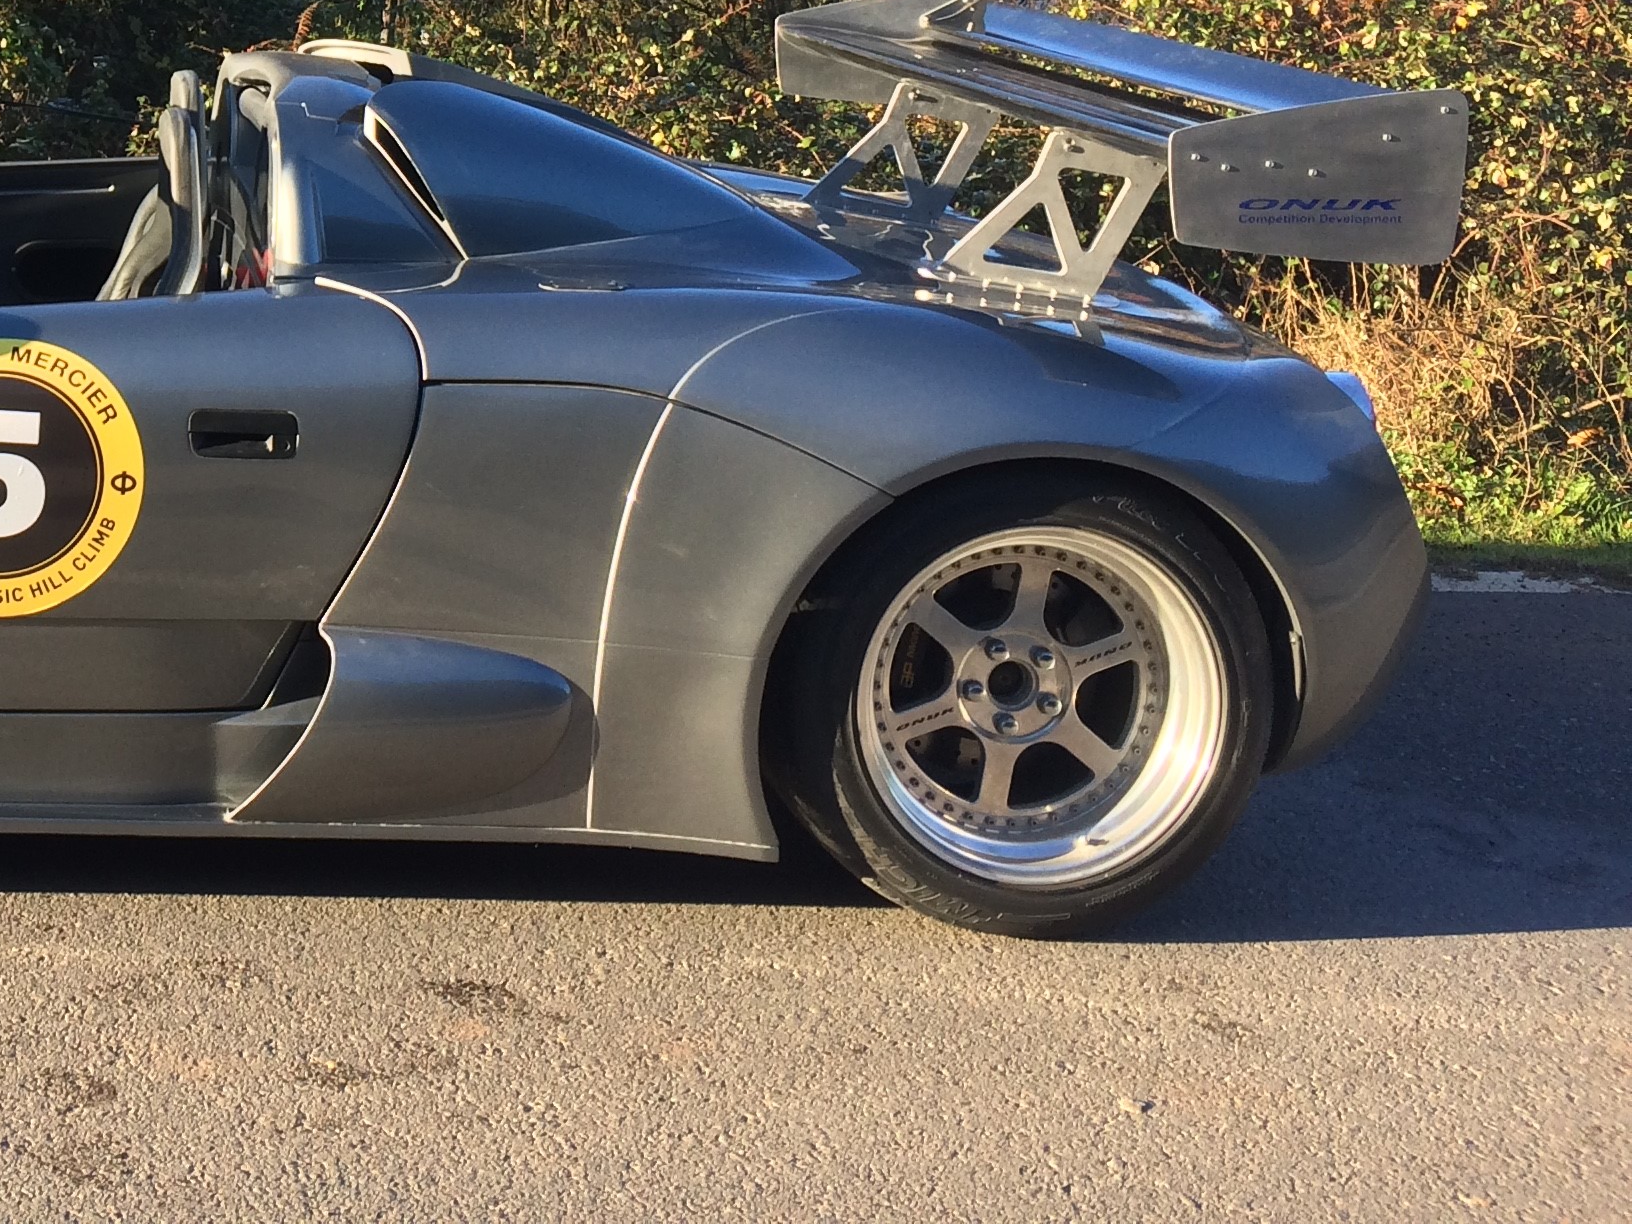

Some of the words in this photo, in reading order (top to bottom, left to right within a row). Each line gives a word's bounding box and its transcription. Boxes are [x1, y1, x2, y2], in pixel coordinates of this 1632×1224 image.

[1238, 198, 1402, 211] ONUK
[1238, 213, 1315, 226] Competition
[1319, 213, 1402, 226] Development
[11, 346, 118, 425] MERCIER
[28, 570, 73, 599] HILL
[72, 517, 116, 571] CLIMB
[1074, 641, 1133, 668] ONUK
[895, 707, 954, 732] ONUK
